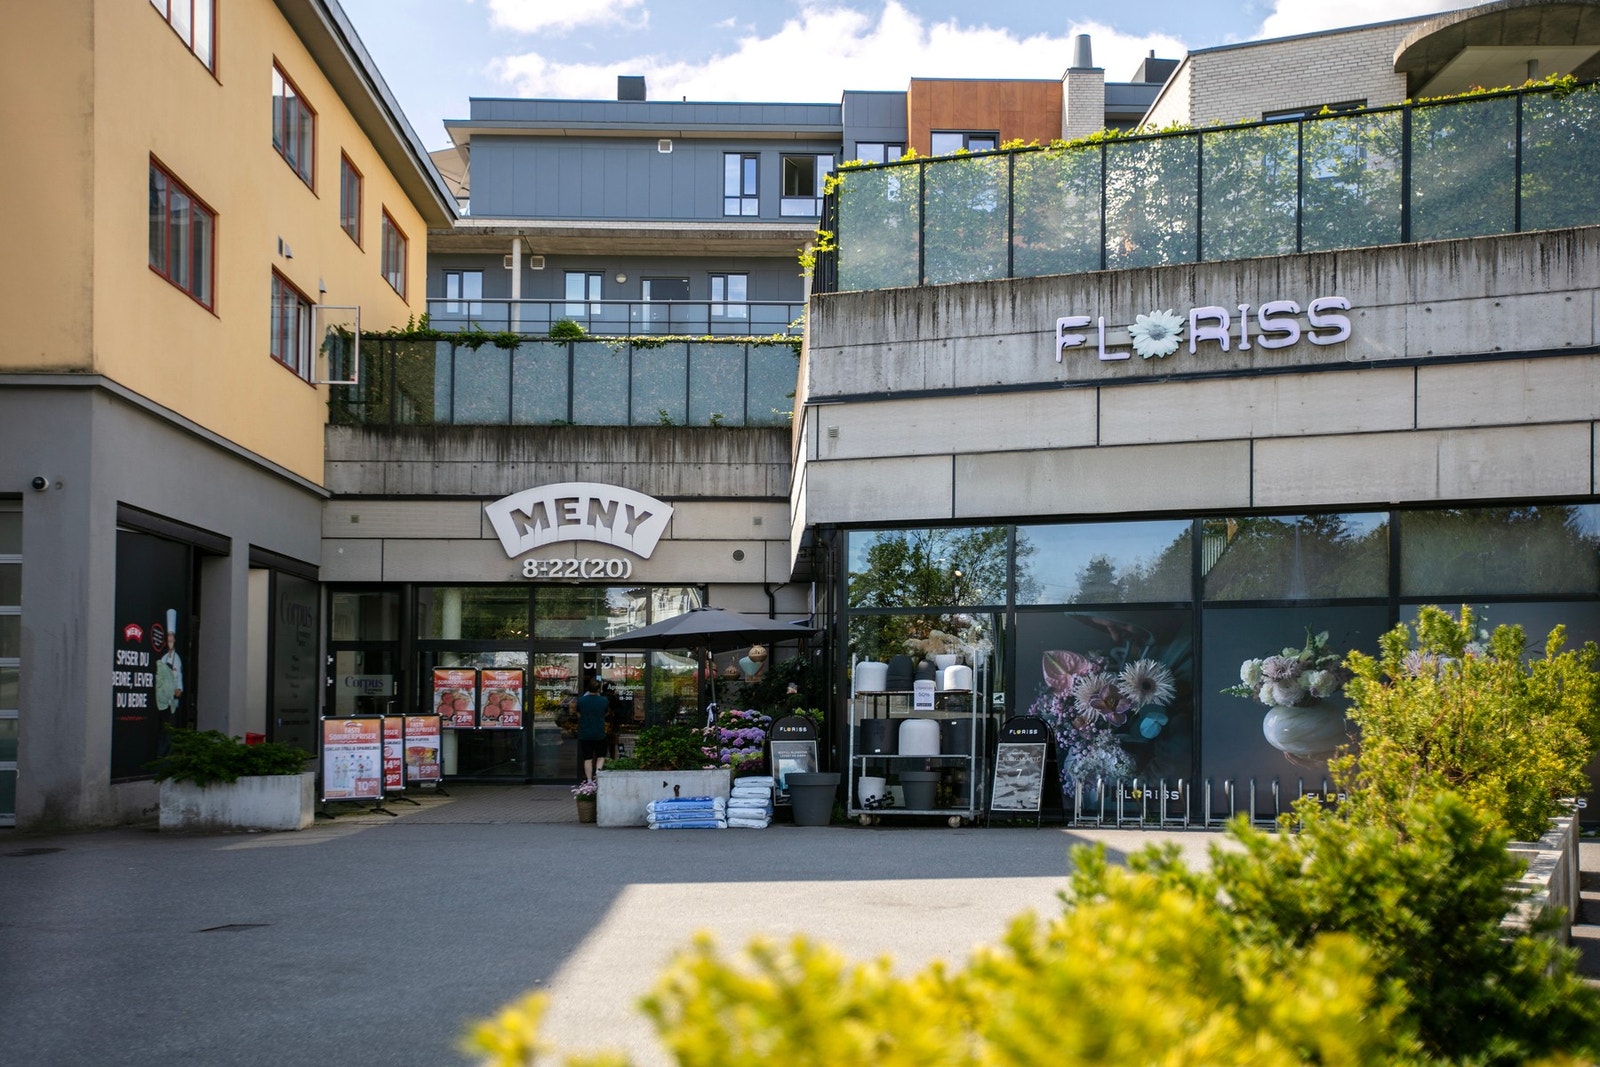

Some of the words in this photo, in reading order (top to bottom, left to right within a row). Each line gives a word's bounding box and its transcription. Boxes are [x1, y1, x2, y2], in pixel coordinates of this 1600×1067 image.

[509, 497, 654, 538] MENY
[522, 558, 633, 580] 8-22(20)
[116, 650, 139, 666] SPISER
[140, 652, 150, 667] DU
[134, 672, 154, 688] LEVER
[344, 675, 384, 693] Corpus
[116, 693, 127, 708] DU
[128, 693, 148, 708] BEDRE
[1015, 768, 1023, 779] 7
